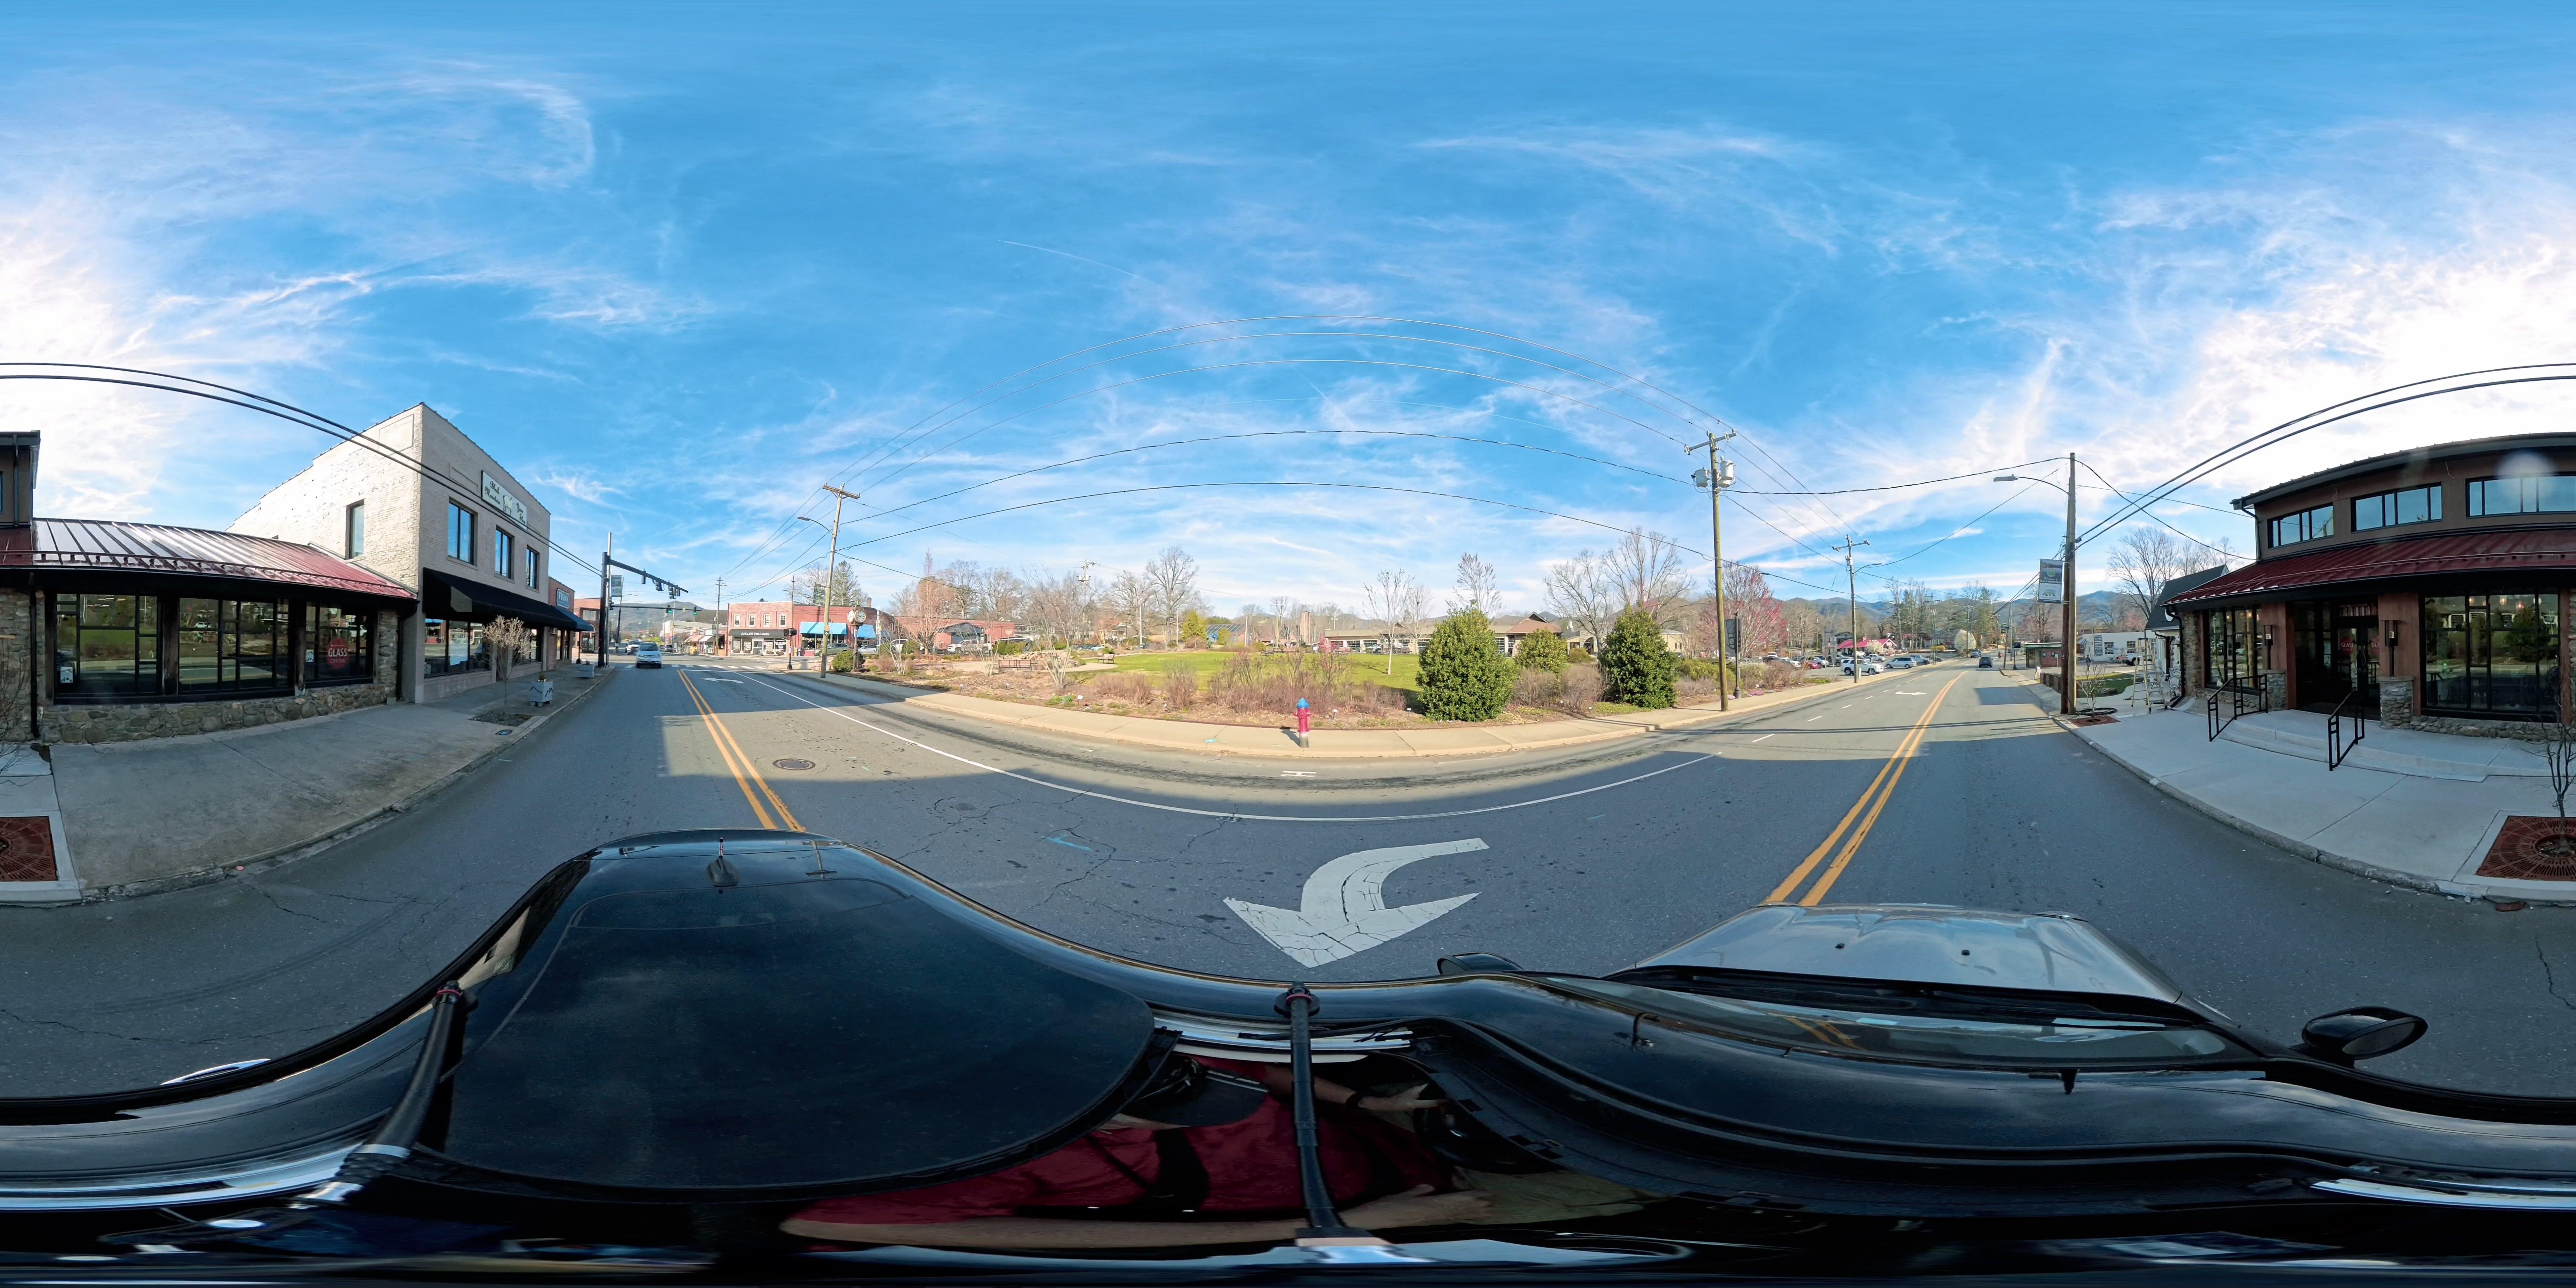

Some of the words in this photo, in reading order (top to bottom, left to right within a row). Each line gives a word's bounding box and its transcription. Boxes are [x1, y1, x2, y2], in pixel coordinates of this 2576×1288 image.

[490, 481, 500, 494] Black
[485, 486, 500, 504] Mountain
[558, 591, 569, 602] TYSON
[328, 648, 347, 657] GLASS
